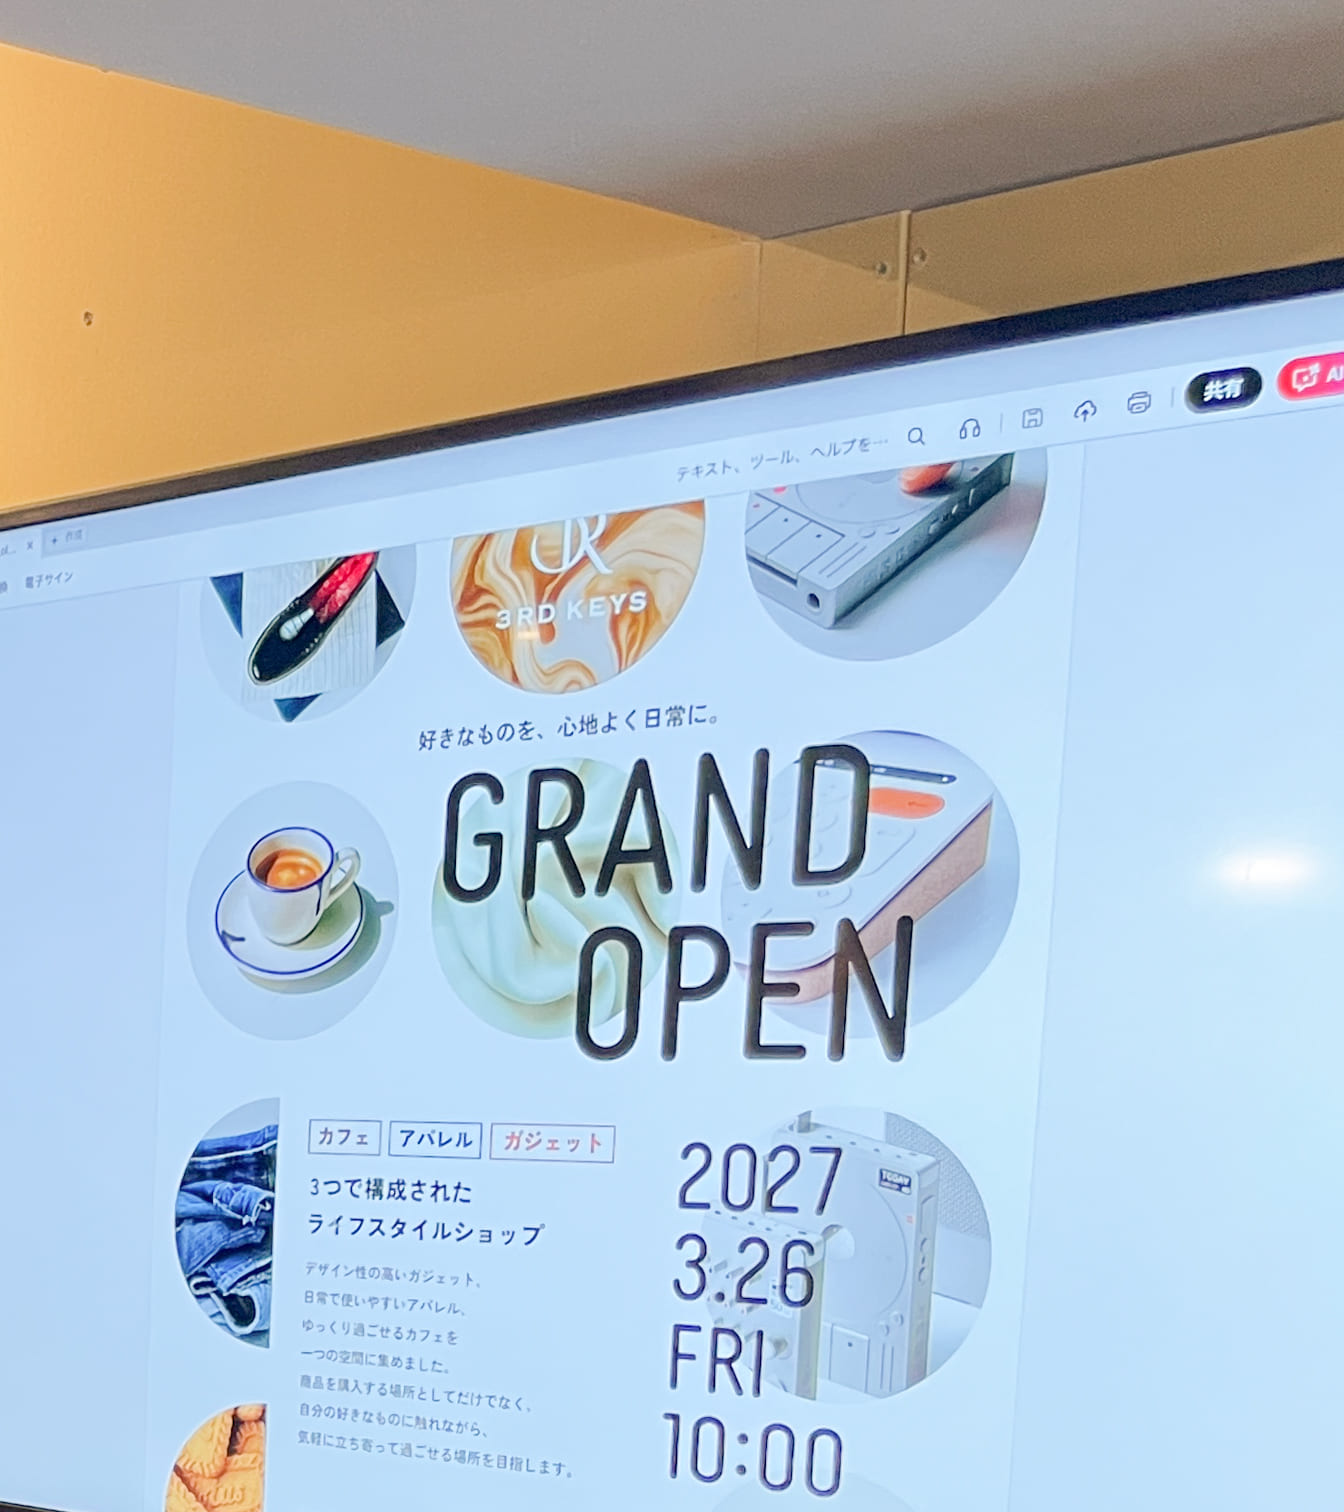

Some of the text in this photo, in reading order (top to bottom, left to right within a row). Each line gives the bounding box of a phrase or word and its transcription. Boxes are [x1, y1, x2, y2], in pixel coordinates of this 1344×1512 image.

[1203, 377, 1244, 402] 共有
[25, 571, 73, 590] 電子サイン
[496, 590, 647, 630] 3RD KEYS
[417, 701, 720, 752] 好きなものを、心地よく日常に。
[441, 743, 872, 904] GRAND
[574, 914, 915, 1064] OPEN
[319, 1127, 369, 1146] カフェ
[504, 1131, 602, 1153] ガジェット
[309, 1177, 473, 1204] 3つで構成された
[677, 1141, 844, 1216] 2027
[308, 1213, 546, 1246] ライフスタイルショップ
[672, 1233, 815, 1309] 3.26
[302, 1319, 459, 1346] ゆっくり過ごせるカフェを
[300, 1349, 450, 1374] 一つの空間に集めました。
[668, 1323, 764, 1398] FRI
[662, 1411, 843, 1497] 10:00
